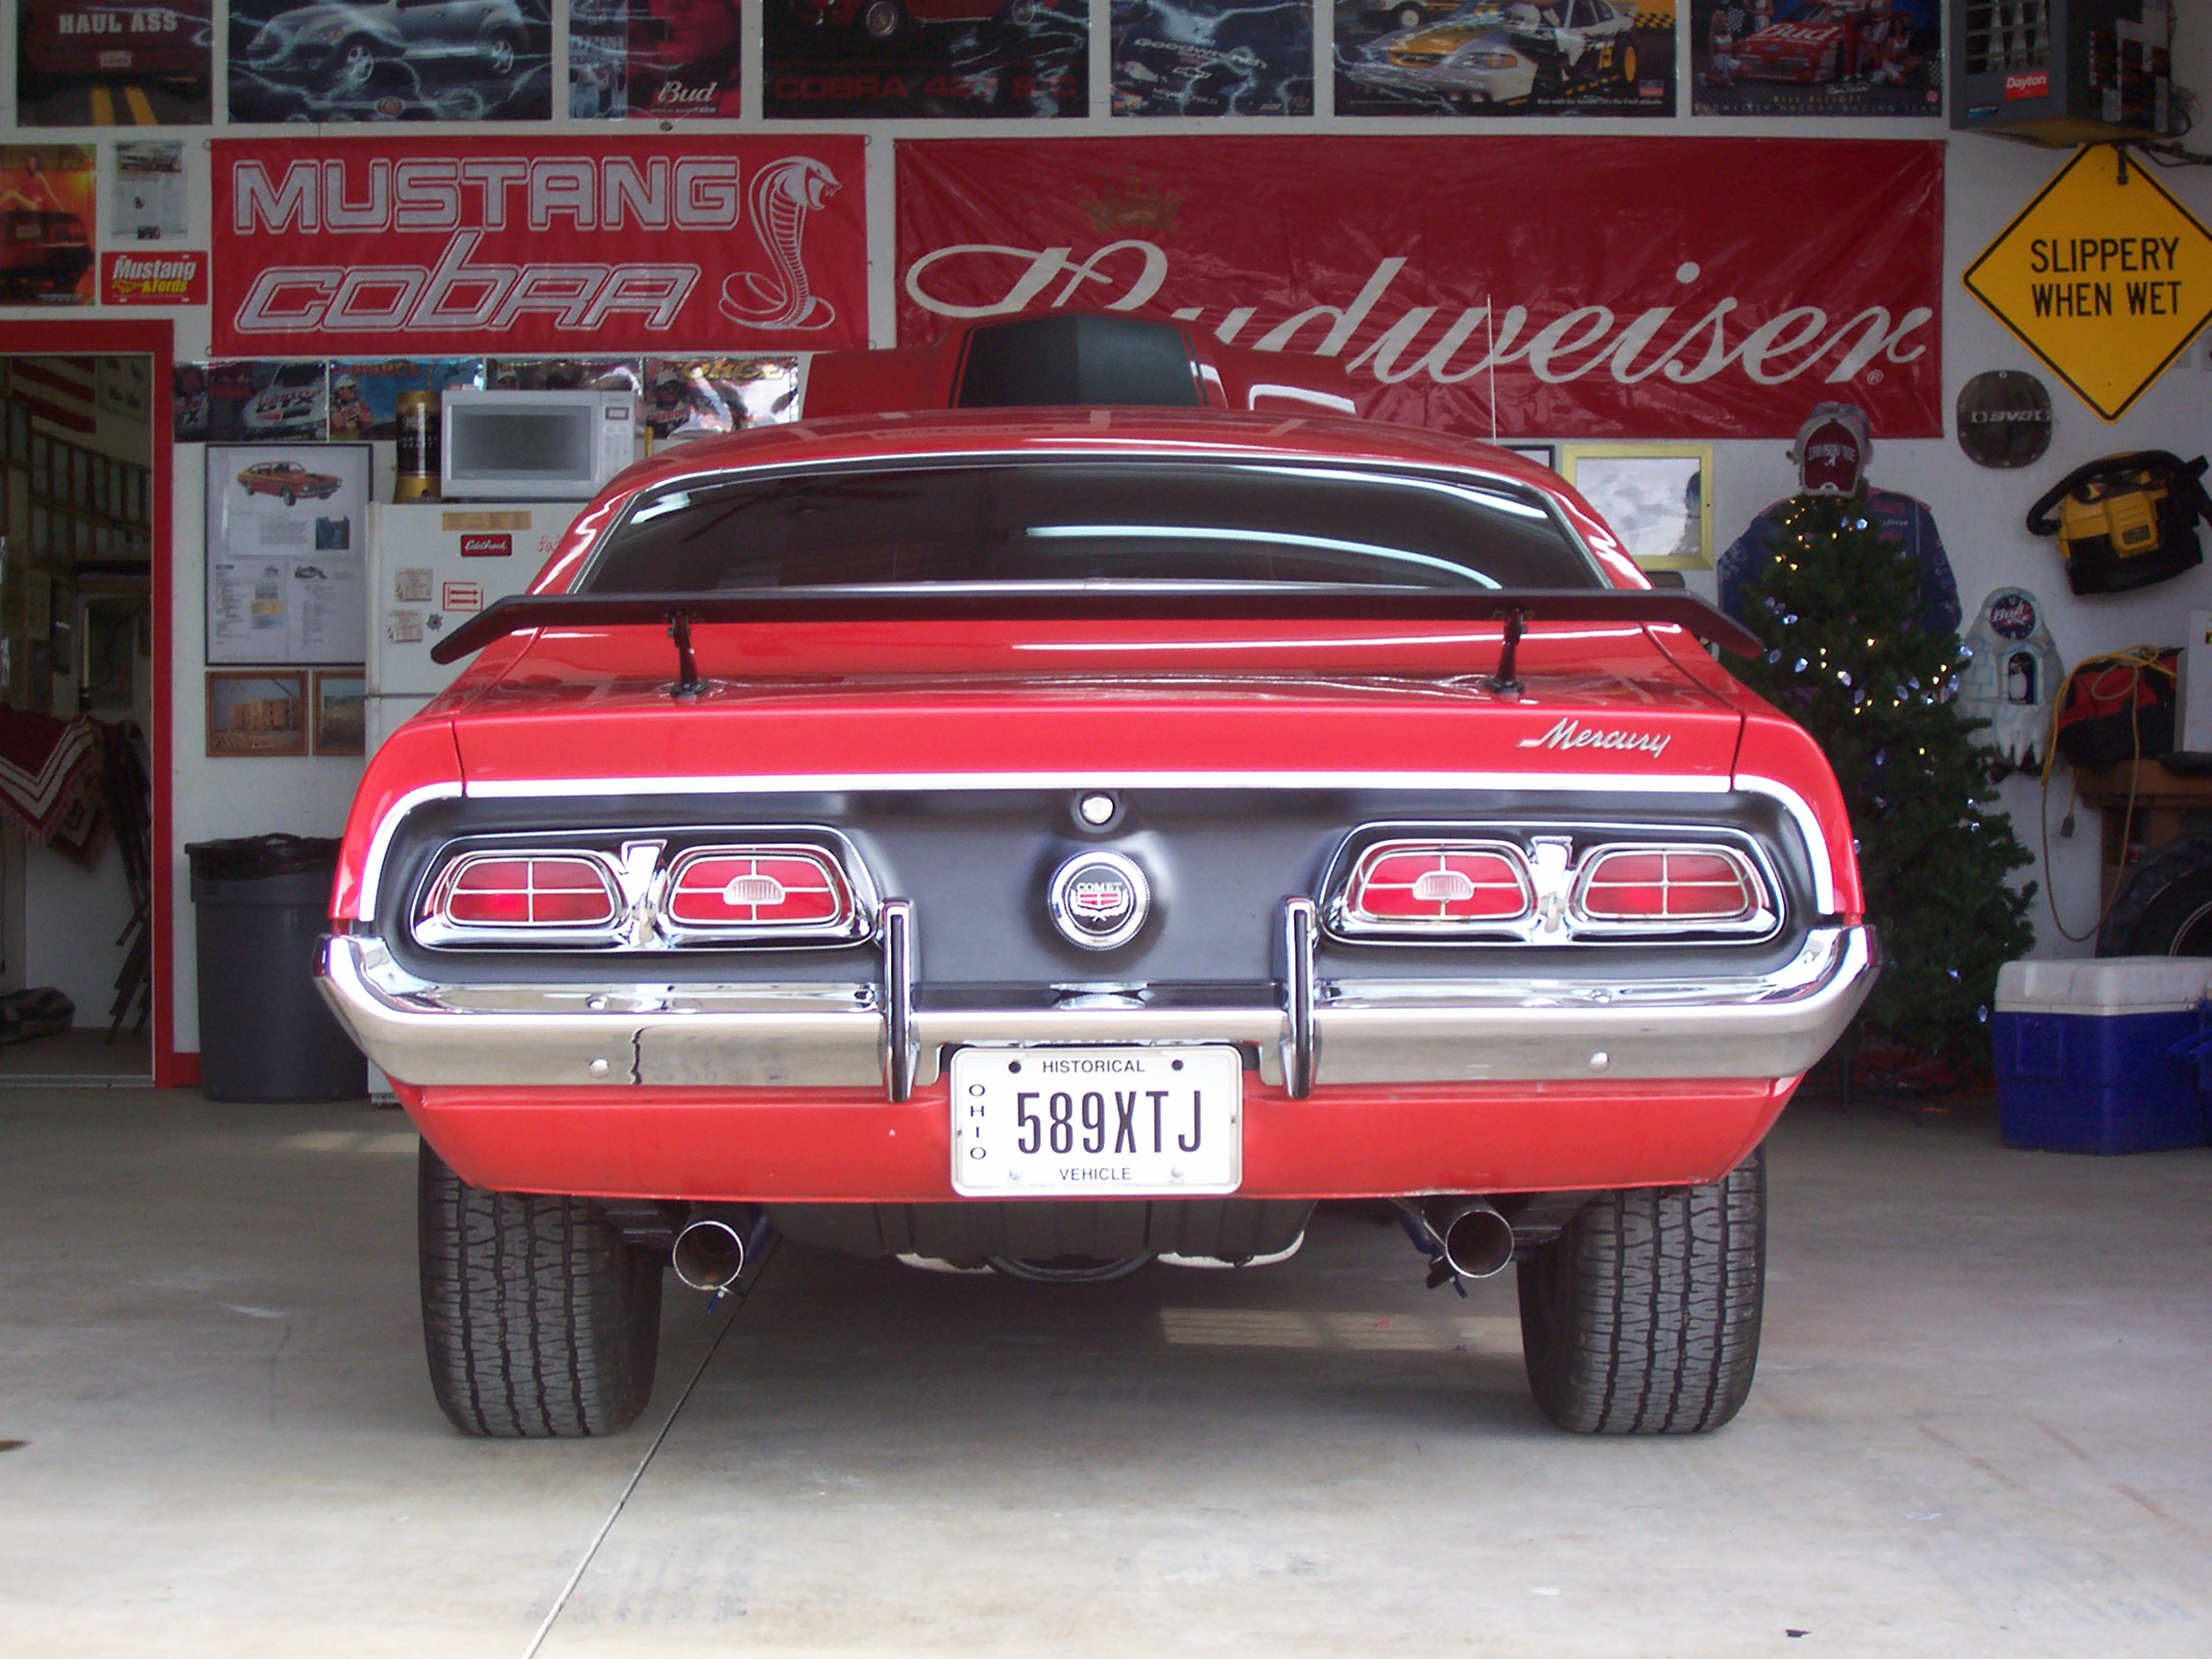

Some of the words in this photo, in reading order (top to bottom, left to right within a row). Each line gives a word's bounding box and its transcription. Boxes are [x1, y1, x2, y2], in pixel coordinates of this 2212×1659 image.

[59, 13, 123, 35] HAUL
[131, 12, 179, 33] ASS
[658, 79, 718, 104] Bud
[774, 76, 909, 99] COBRA
[2005, 74, 2047, 91] Dayton
[233, 156, 739, 235] MUSTANG
[2031, 237, 2180, 274] SLIPPERY
[112, 258, 197, 281] Mustang
[2032, 282, 2112, 317] WHEN
[2126, 279, 2182, 316] WET
[902, 239, 1933, 385] Bdweiser
[1516, 716, 1671, 759] Mercury
[1076, 882, 1122, 893] COMET
[1042, 1060, 1146, 1074] HISTORICAL
[968, 1083, 987, 1161] OHIO
[1017, 1090, 1202, 1155] 589XTJ
[1058, 1166, 1132, 1182] VEHICLE
